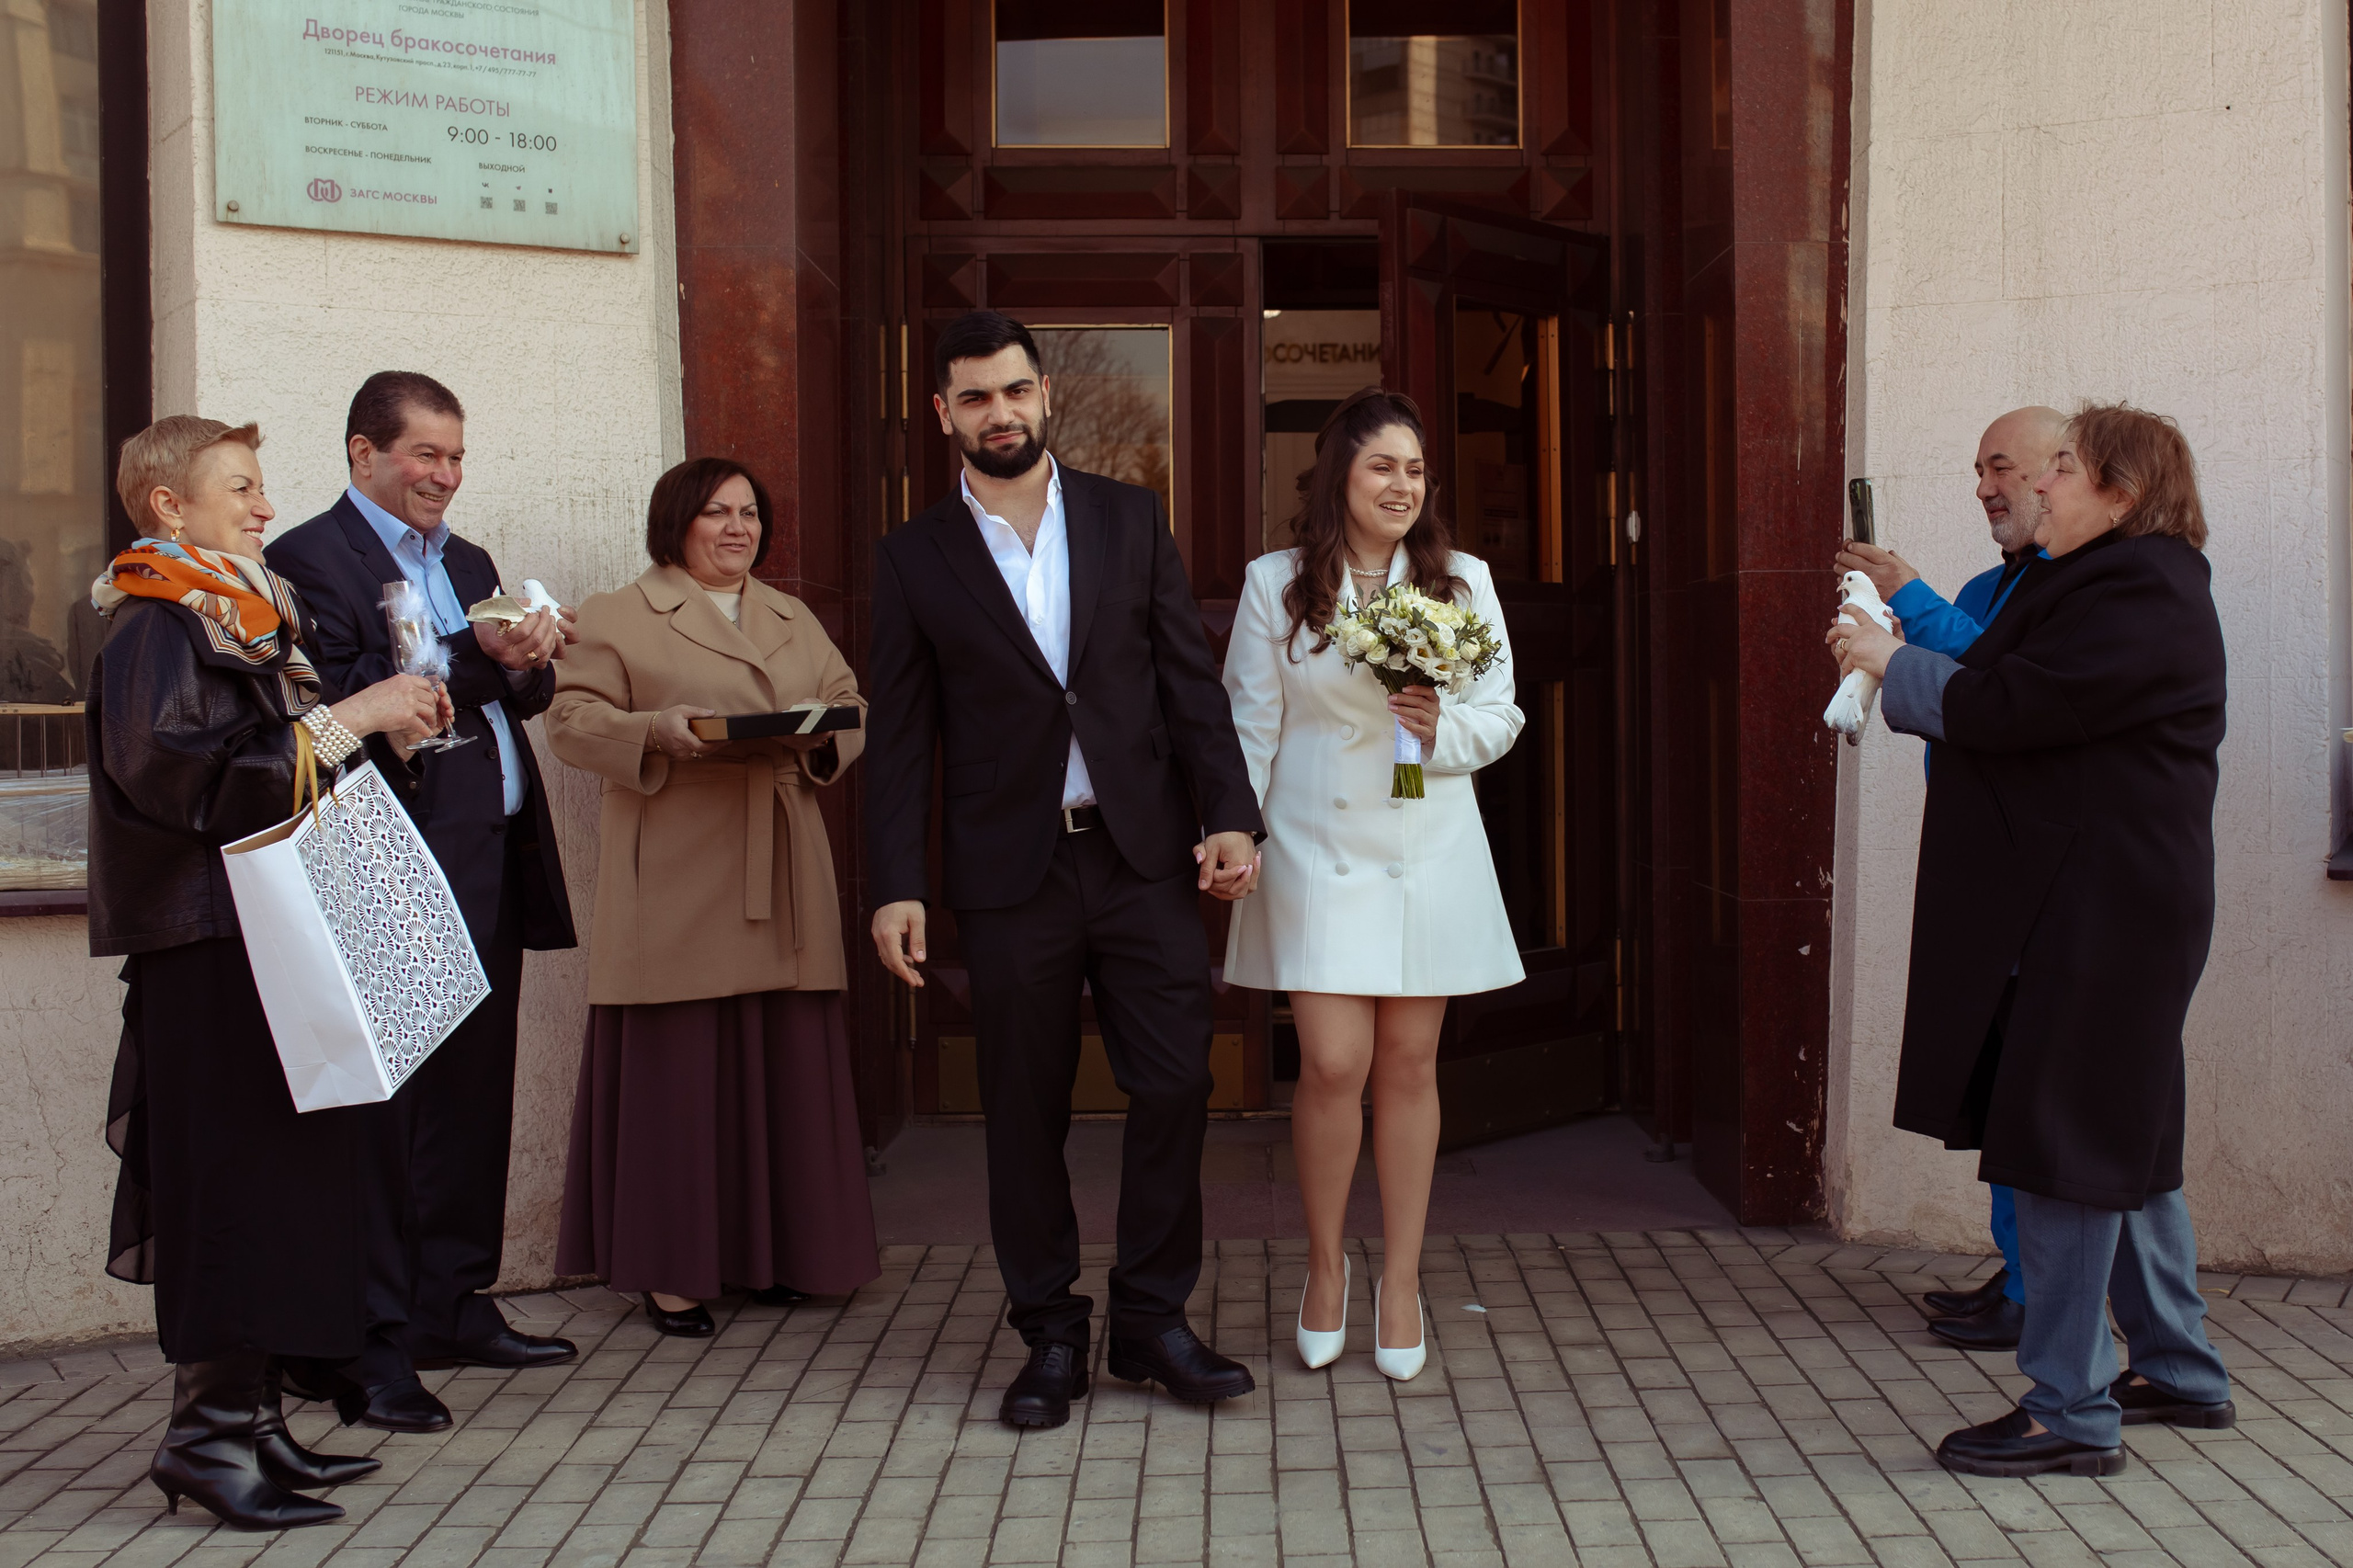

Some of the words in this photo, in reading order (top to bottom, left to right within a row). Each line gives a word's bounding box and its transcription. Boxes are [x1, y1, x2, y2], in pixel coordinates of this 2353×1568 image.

[398, 5, 429, 15] ГОРОДА
[431, 8, 465, 19] МОСКВЫ
[494, 4, 540, 17] СОСТОЯНИЯ
[302, 18, 384, 49] Дворец
[390, 28, 556, 65] бракосочетания
[355, 85, 429, 109] РЕЖИМ
[436, 94, 510, 118] РАБОТЫ
[304, 116, 344, 128] ВТОРНИК
[350, 120, 389, 132] СУББОТА
[447, 125, 489, 145] 9:00
[508, 131, 557, 153] 18:00
[304, 144, 364, 159] ВОСКРЕСЕНЬЕ
[369, 151, 432, 165] ПОНЕДЕЛЬНИК
[478, 162, 526, 174] ВЫХОДНОЙ
[349, 187, 381, 200] ЗАГС
[382, 191, 438, 205] МОСКВЫ
